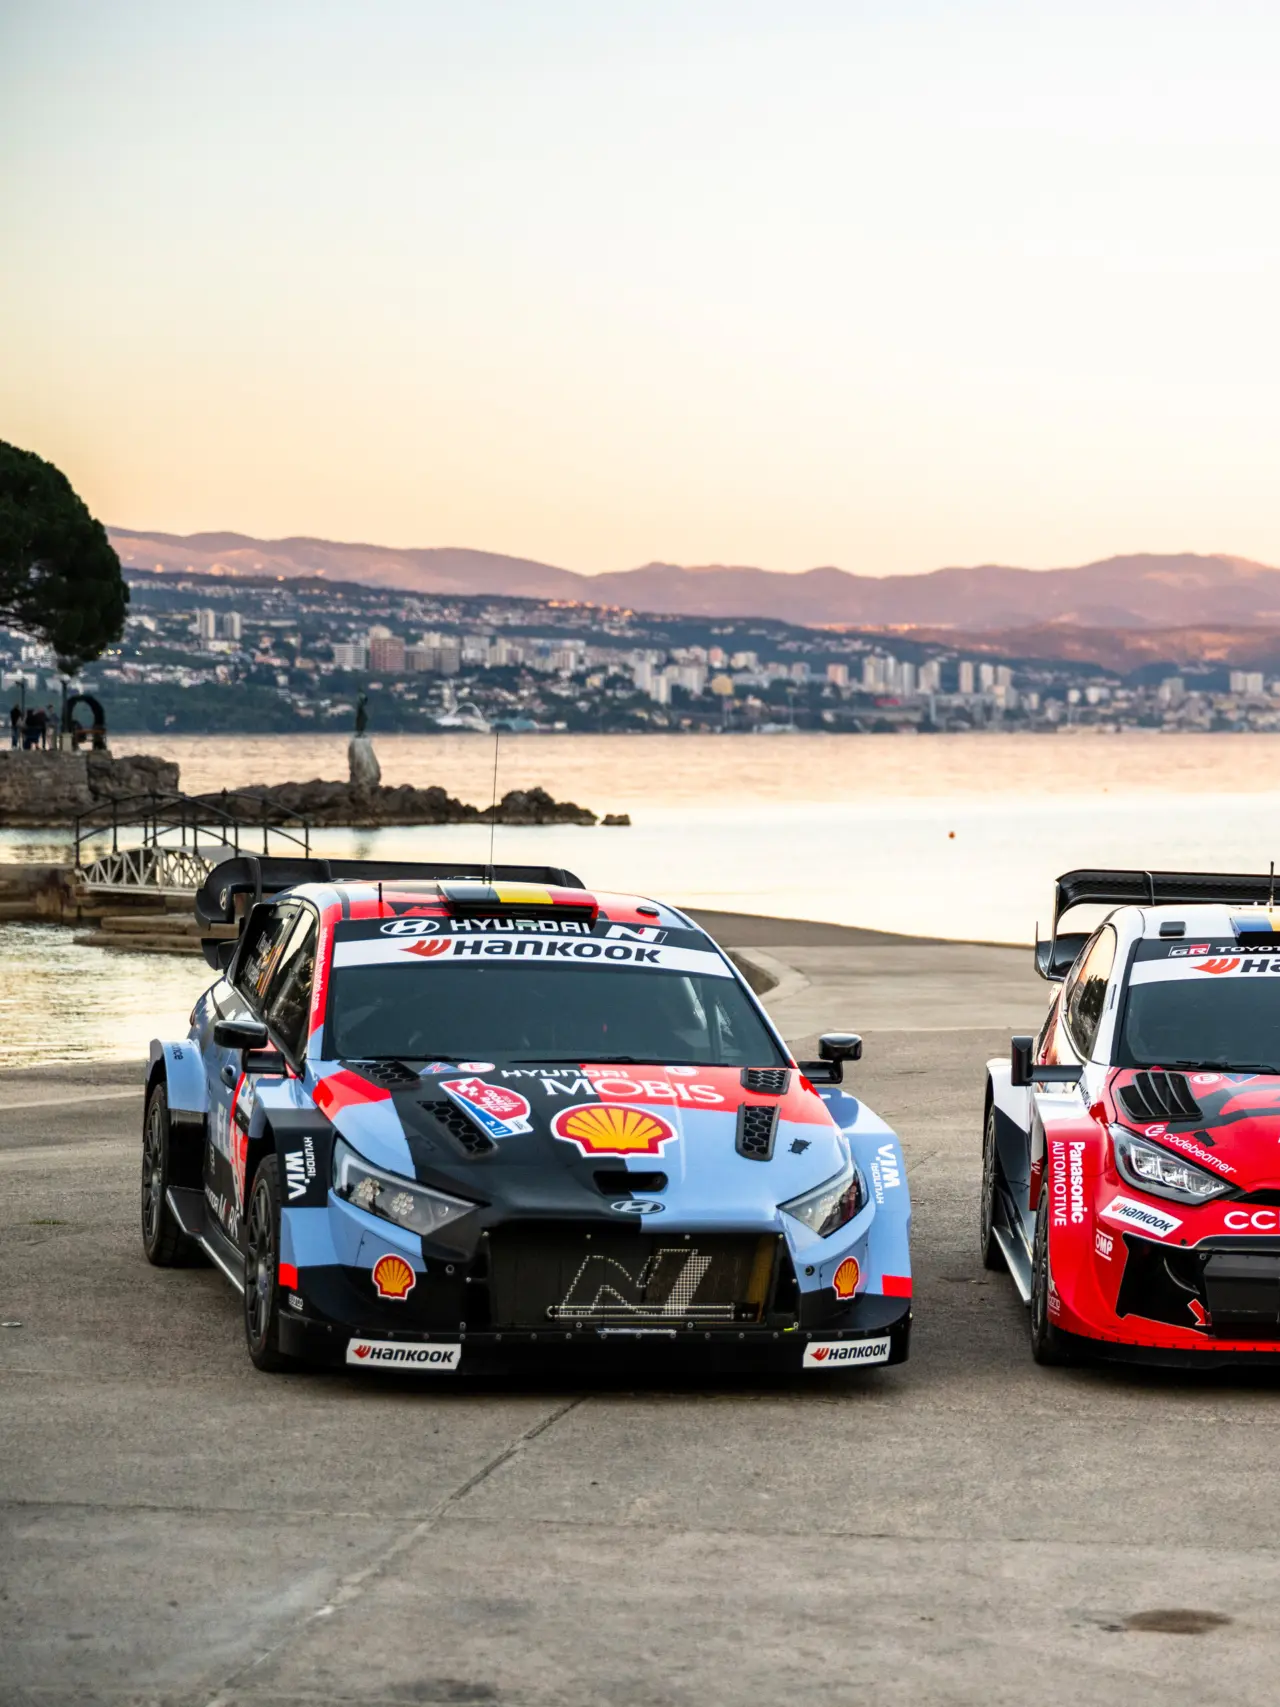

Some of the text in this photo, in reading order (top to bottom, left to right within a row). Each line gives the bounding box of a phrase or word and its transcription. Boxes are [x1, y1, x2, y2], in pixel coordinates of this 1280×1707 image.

[449, 918, 592, 934] HYUNDAI
[453, 940, 662, 964] HANKOOK
[1171, 944, 1210, 957] GR
[501, 1069, 630, 1079] HYUNDAI
[540, 1078, 725, 1104] MOBIS
[304, 1136, 317, 1177] HYUNDAI
[1163, 1132, 1236, 1174] codebeamer
[870, 1162, 885, 1205] HYUNDAI
[1051, 1140, 1067, 1227] AUTOMOTIVE
[1068, 1141, 1089, 1224] Panasonic
[1119, 1204, 1174, 1232] HANKOOK
[1095, 1234, 1114, 1256] OMP
[370, 1346, 455, 1364] HANKOOK
[828, 1343, 888, 1361] HANKOOK
